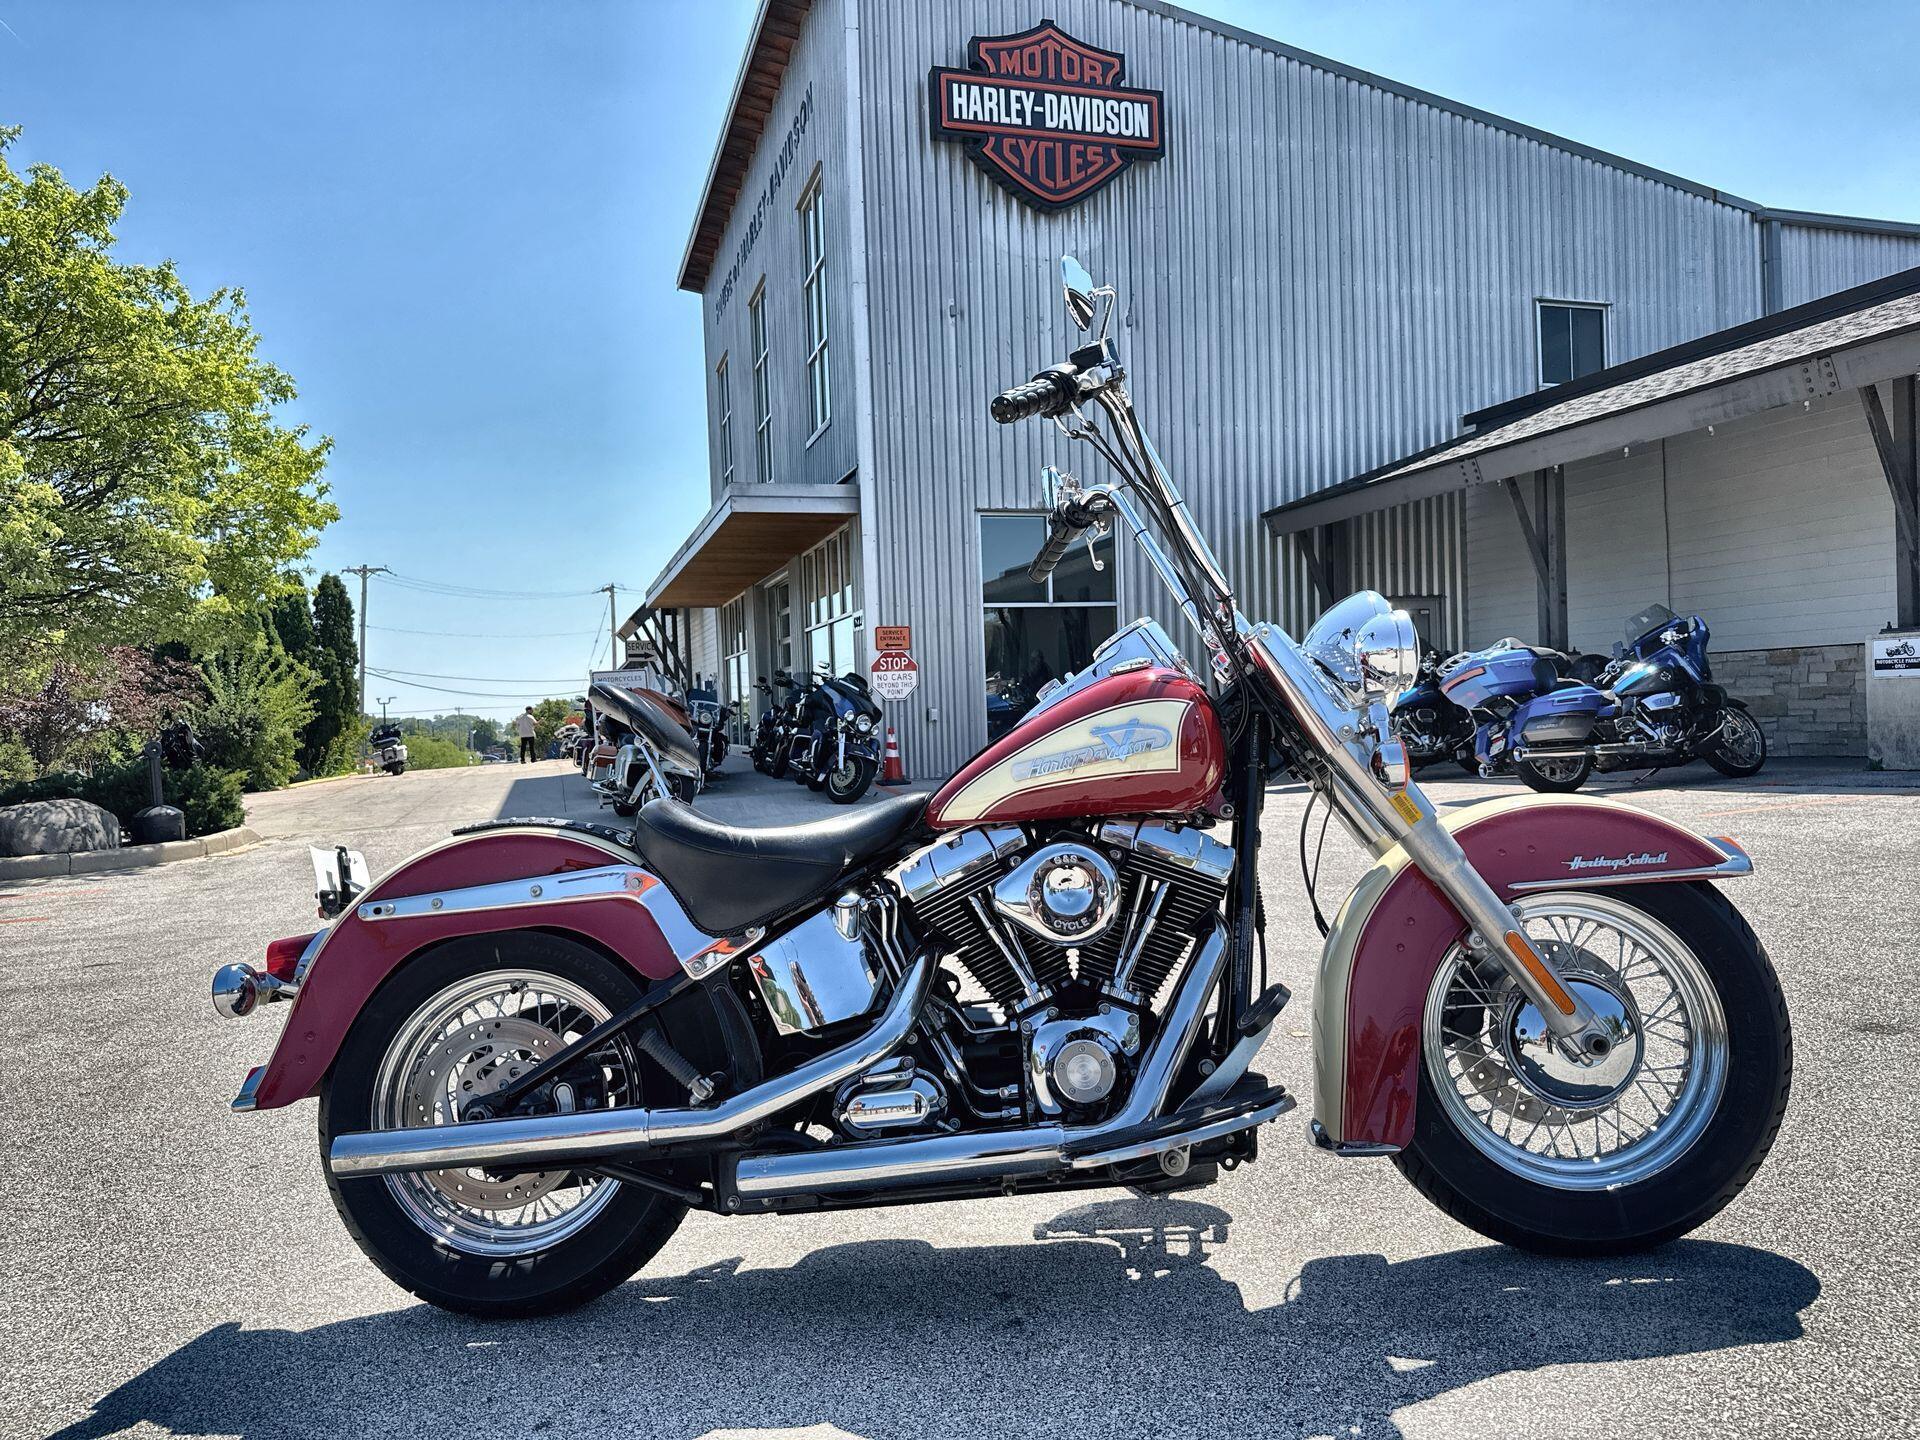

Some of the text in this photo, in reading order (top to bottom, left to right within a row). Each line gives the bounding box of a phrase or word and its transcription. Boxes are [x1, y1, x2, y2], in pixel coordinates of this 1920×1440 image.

[999, 38, 1103, 86] MOTOR
[952, 83, 1150, 138] HARLEY-DAVIDSON
[741, 81, 814, 268] HARLEY-DAVIDSON
[1003, 137, 1104, 189] CYCLES
[876, 672, 913, 681] NO CARS
[879, 657, 909, 670] STOP
[1053, 854, 1078, 864] S&S
[1053, 916, 1091, 931] CYCLE
